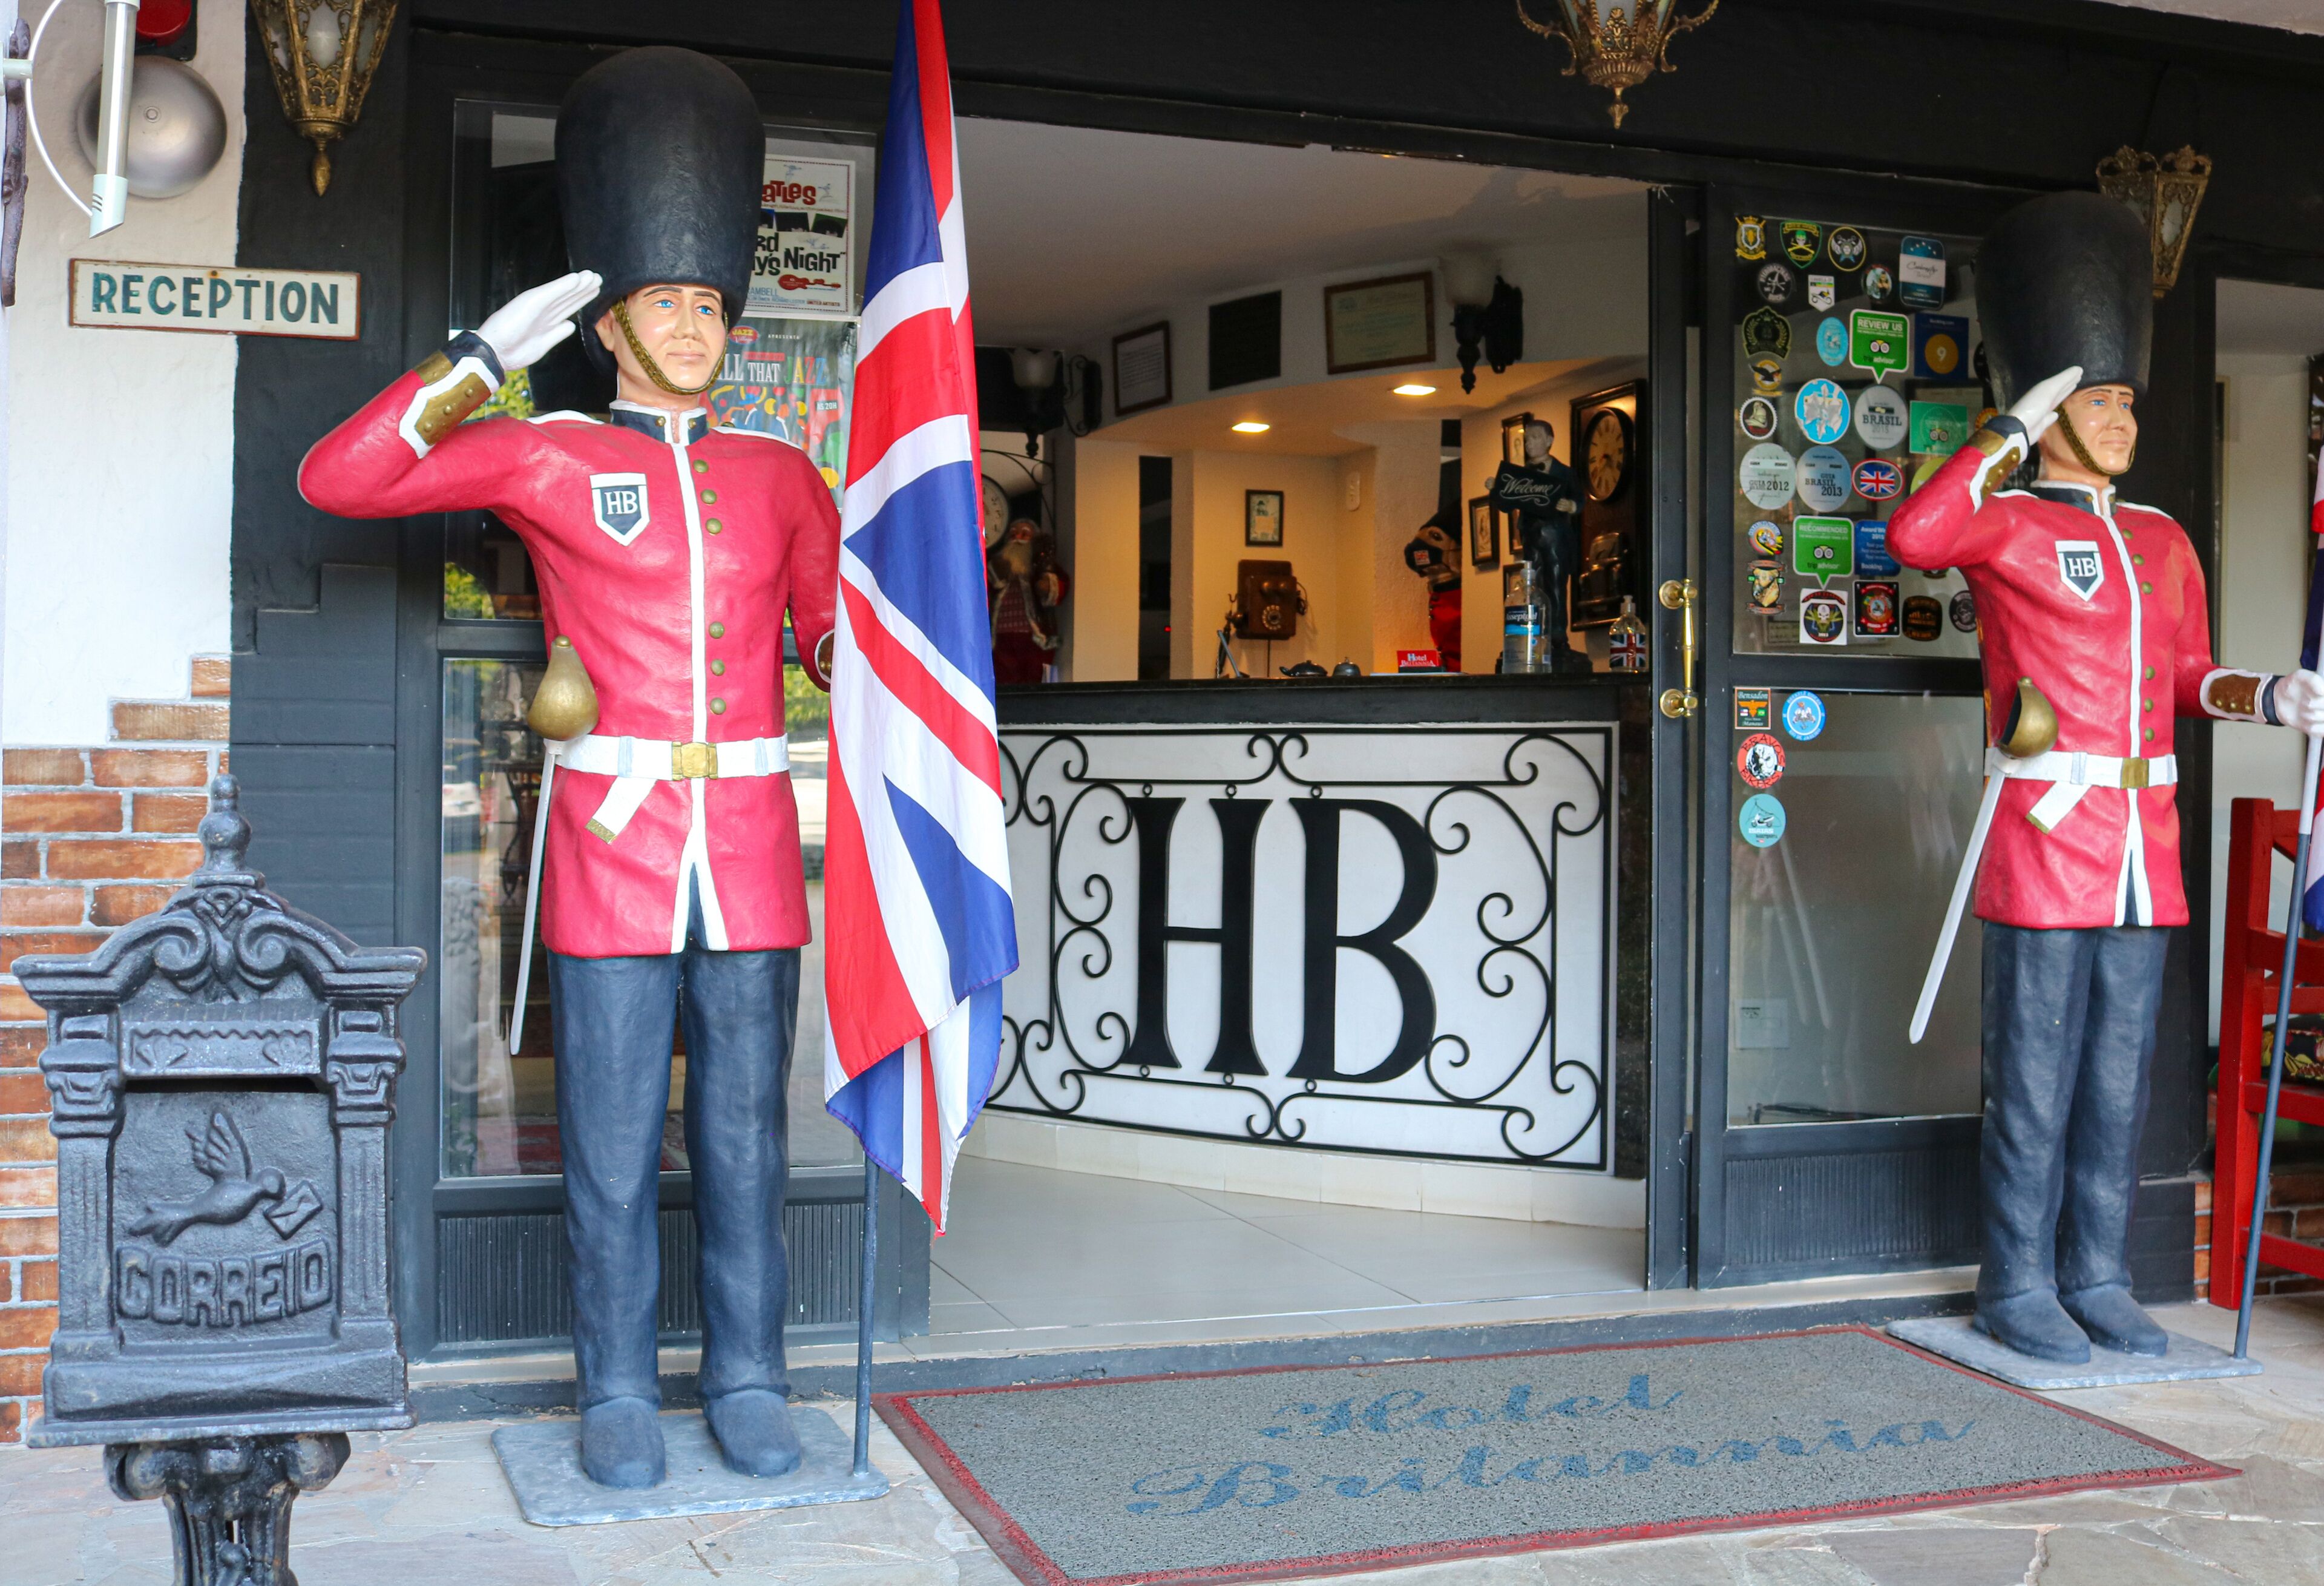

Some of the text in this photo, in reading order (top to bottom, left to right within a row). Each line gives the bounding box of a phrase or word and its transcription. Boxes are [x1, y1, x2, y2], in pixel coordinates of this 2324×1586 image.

[762, 180, 816, 205] aTLes
[752, 252, 780, 276] y's
[92, 272, 338, 324] RECEPTION
[1857, 318, 1903, 332] REVIEW US
[1937, 346, 1947, 361] 9
[718, 353, 827, 385] LL THAT JAZZ
[1862, 415, 1902, 426] BRASIL
[1500, 473, 1561, 500] Welcome
[1767, 481, 1790, 492] 2012
[1805, 478, 1836, 487] BRASIL
[1821, 486, 1843, 496] 2013
[604, 490, 638, 515] HB
[1799, 524, 1848, 534] RECOMMENDED
[2067, 558, 2096, 576] HB
[1118, 797, 1438, 1084] HB
[117, 1239, 333, 1328] CORREIO
[1259, 1374, 1684, 1440] Hotel
